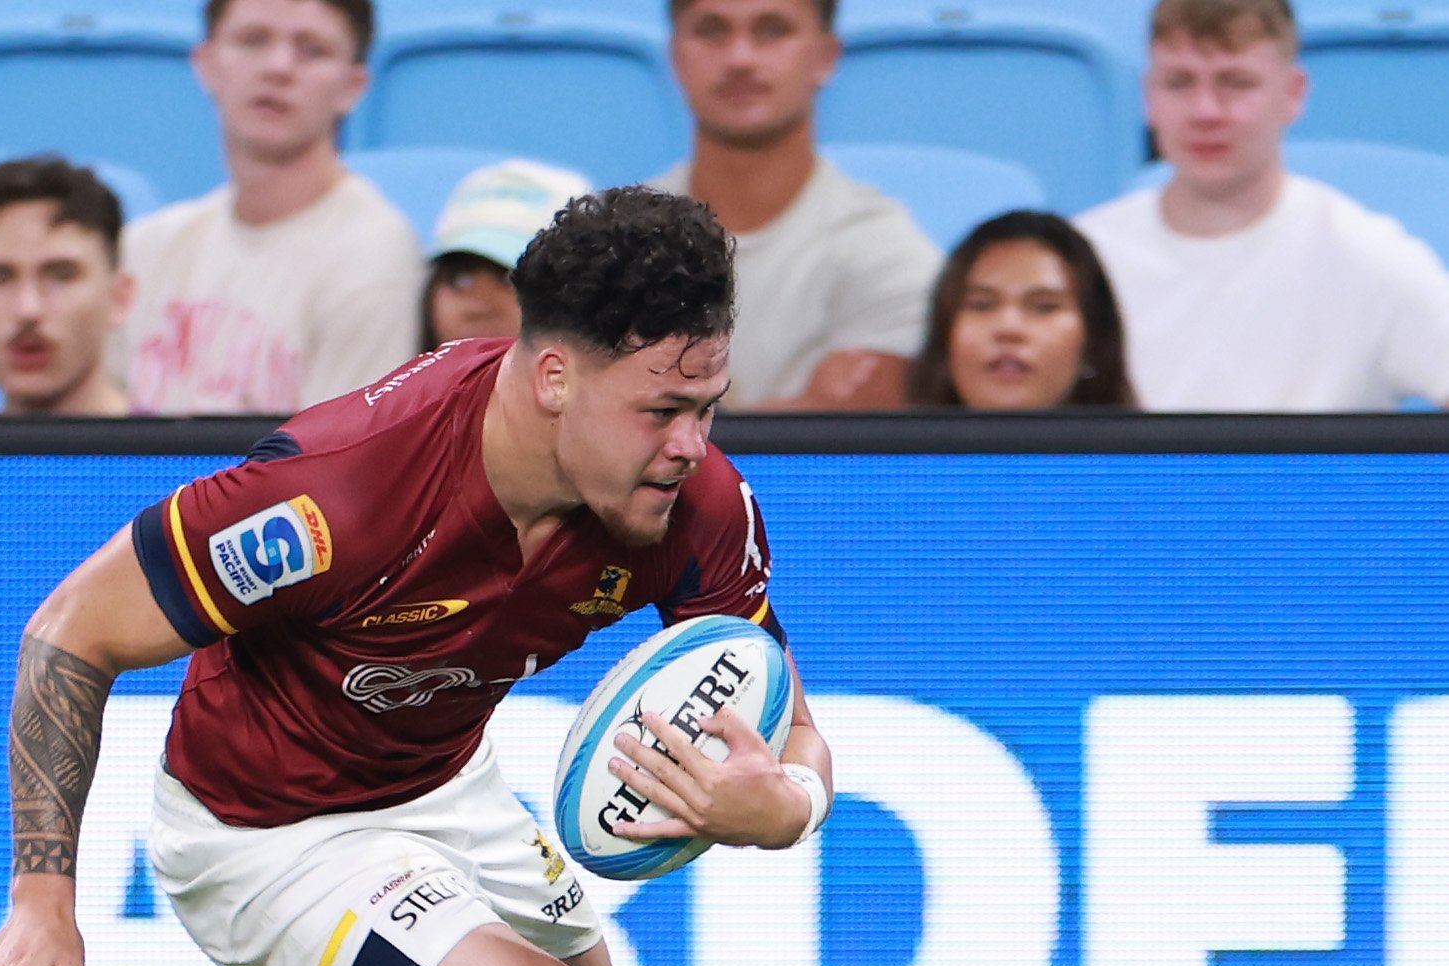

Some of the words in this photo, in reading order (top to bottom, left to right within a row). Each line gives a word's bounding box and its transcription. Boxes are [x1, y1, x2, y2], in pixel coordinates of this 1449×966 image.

[215, 542, 252, 596] PACIFIC
[362, 604, 439, 628] CLASSIC
[598, 650, 750, 838] GIERT
